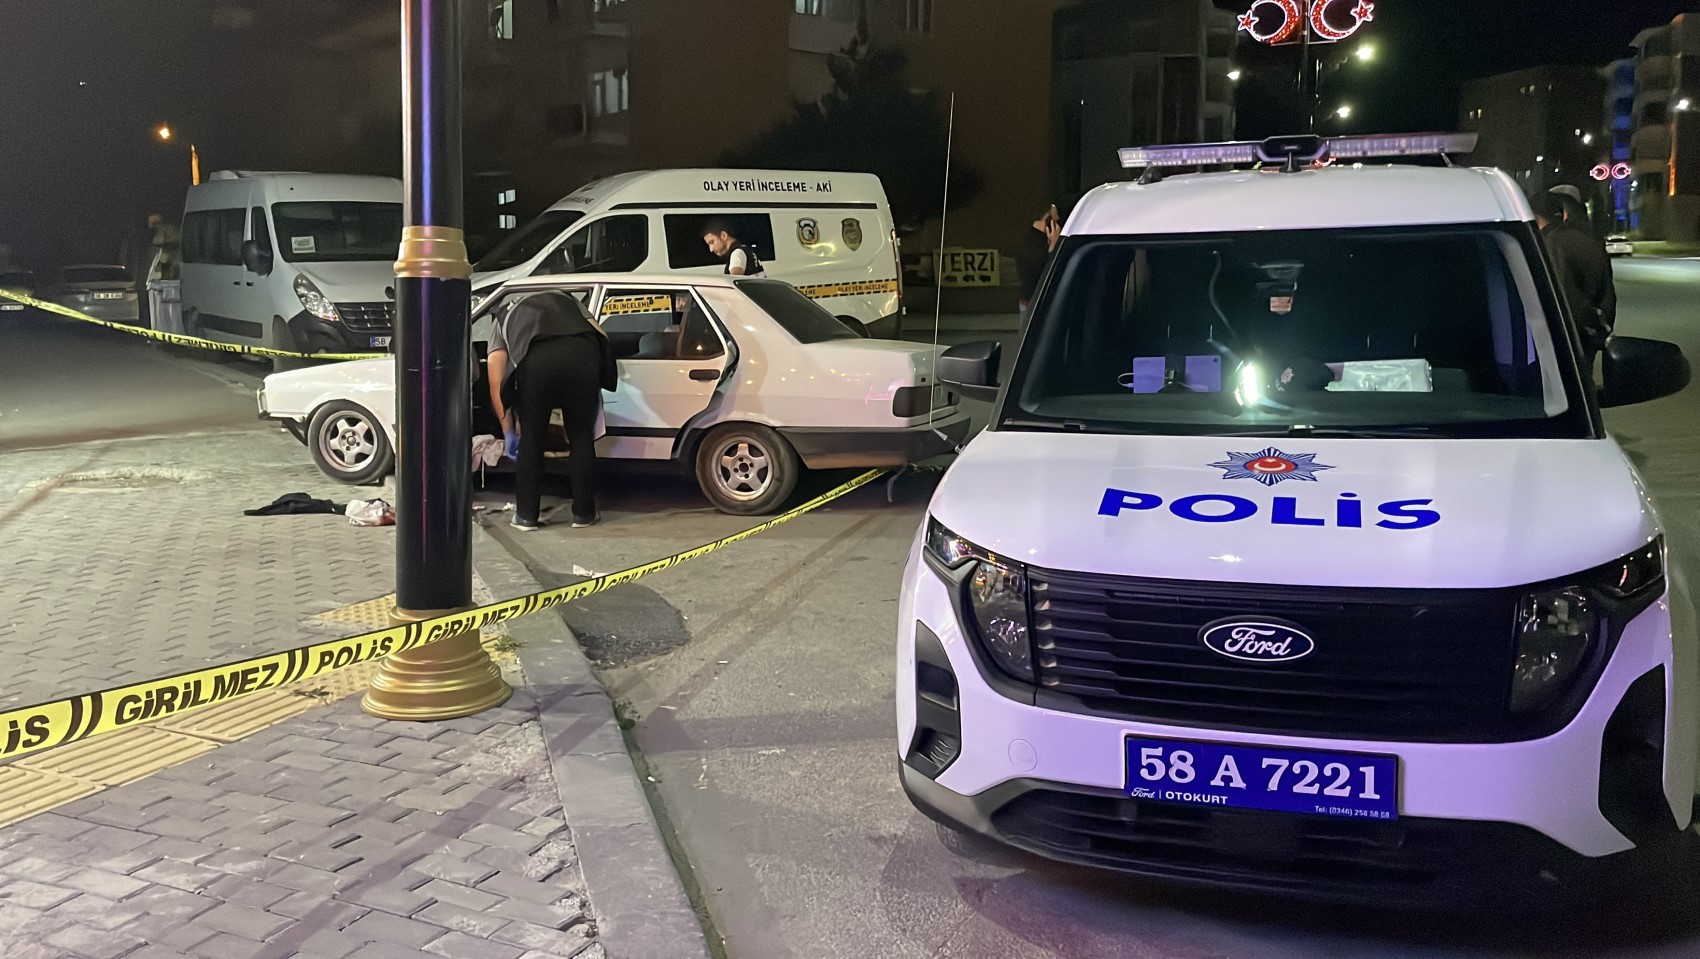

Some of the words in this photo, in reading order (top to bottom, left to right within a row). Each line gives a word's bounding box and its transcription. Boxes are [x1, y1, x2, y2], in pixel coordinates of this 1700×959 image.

[703, 181, 729, 191] OLAY
[732, 179, 755, 191] YERİ
[757, 179, 807, 192] İNCELEME
[816, 180, 832, 192] AKİ
[938, 252, 995, 272] TERZİ
[1098, 487, 1441, 530] POLİS
[1224, 627, 1293, 655] Ford
[115, 662, 280, 726] GİRİLMEZ
[313, 636, 394, 675] POLİS
[1140, 747, 1196, 784] 58
[1210, 754, 1247, 789] A
[1261, 757, 1381, 799] 7221
[1131, 787, 1155, 798] Ford
[1165, 791, 1228, 804] OTOKURT
